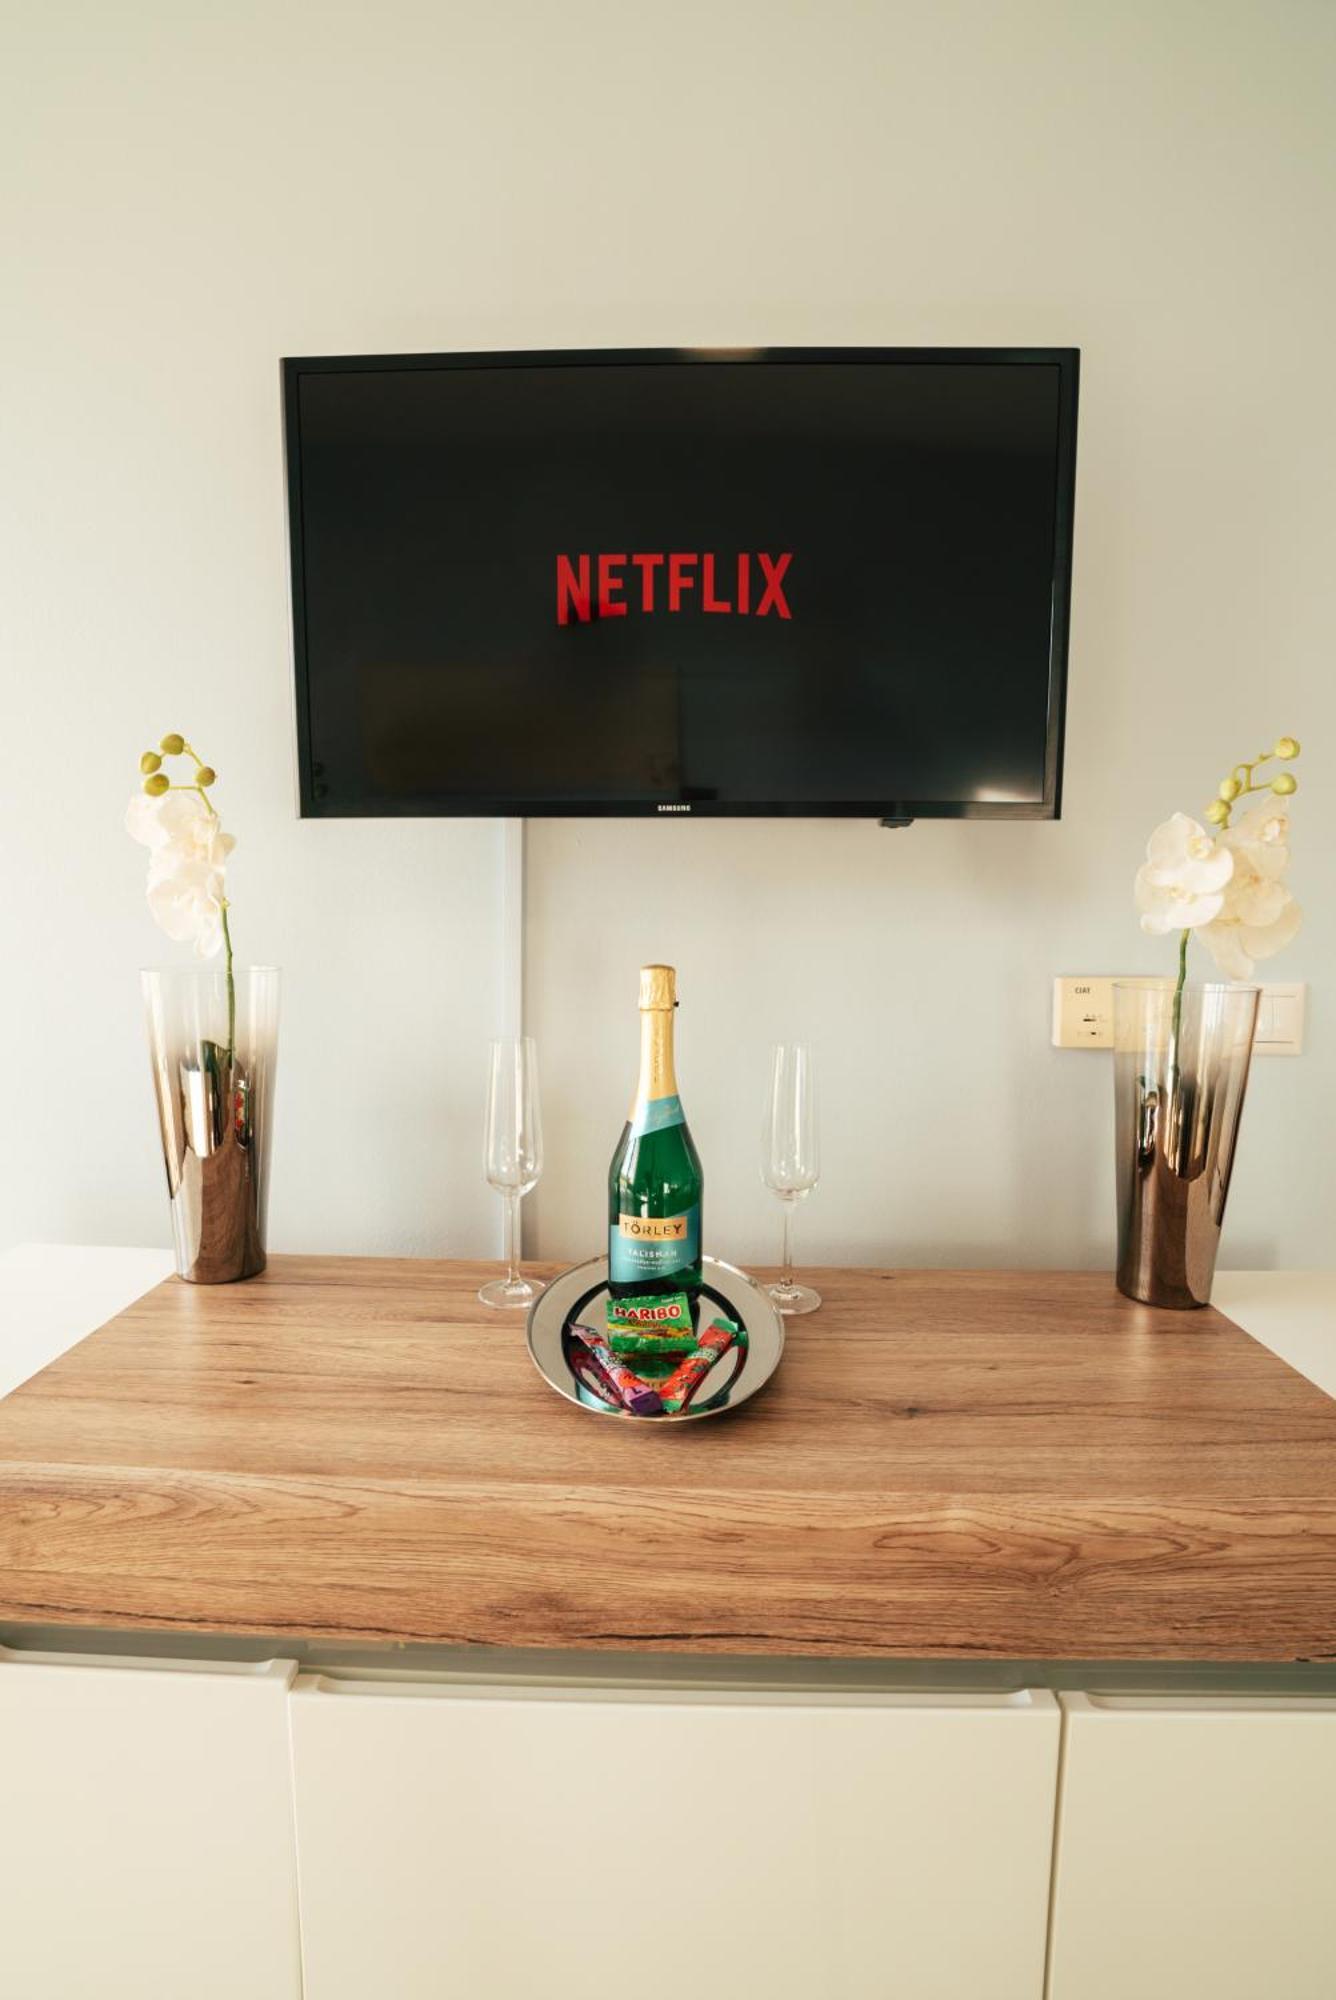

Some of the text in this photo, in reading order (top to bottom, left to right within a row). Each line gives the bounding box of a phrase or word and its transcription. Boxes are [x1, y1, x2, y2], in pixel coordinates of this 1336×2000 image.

[556, 553, 793, 625] NETFLIX
[657, 804, 691, 812] SAMSUNG
[623, 1219, 682, 1236] TÖRLEY
[614, 1304, 681, 1320] HARIBO
